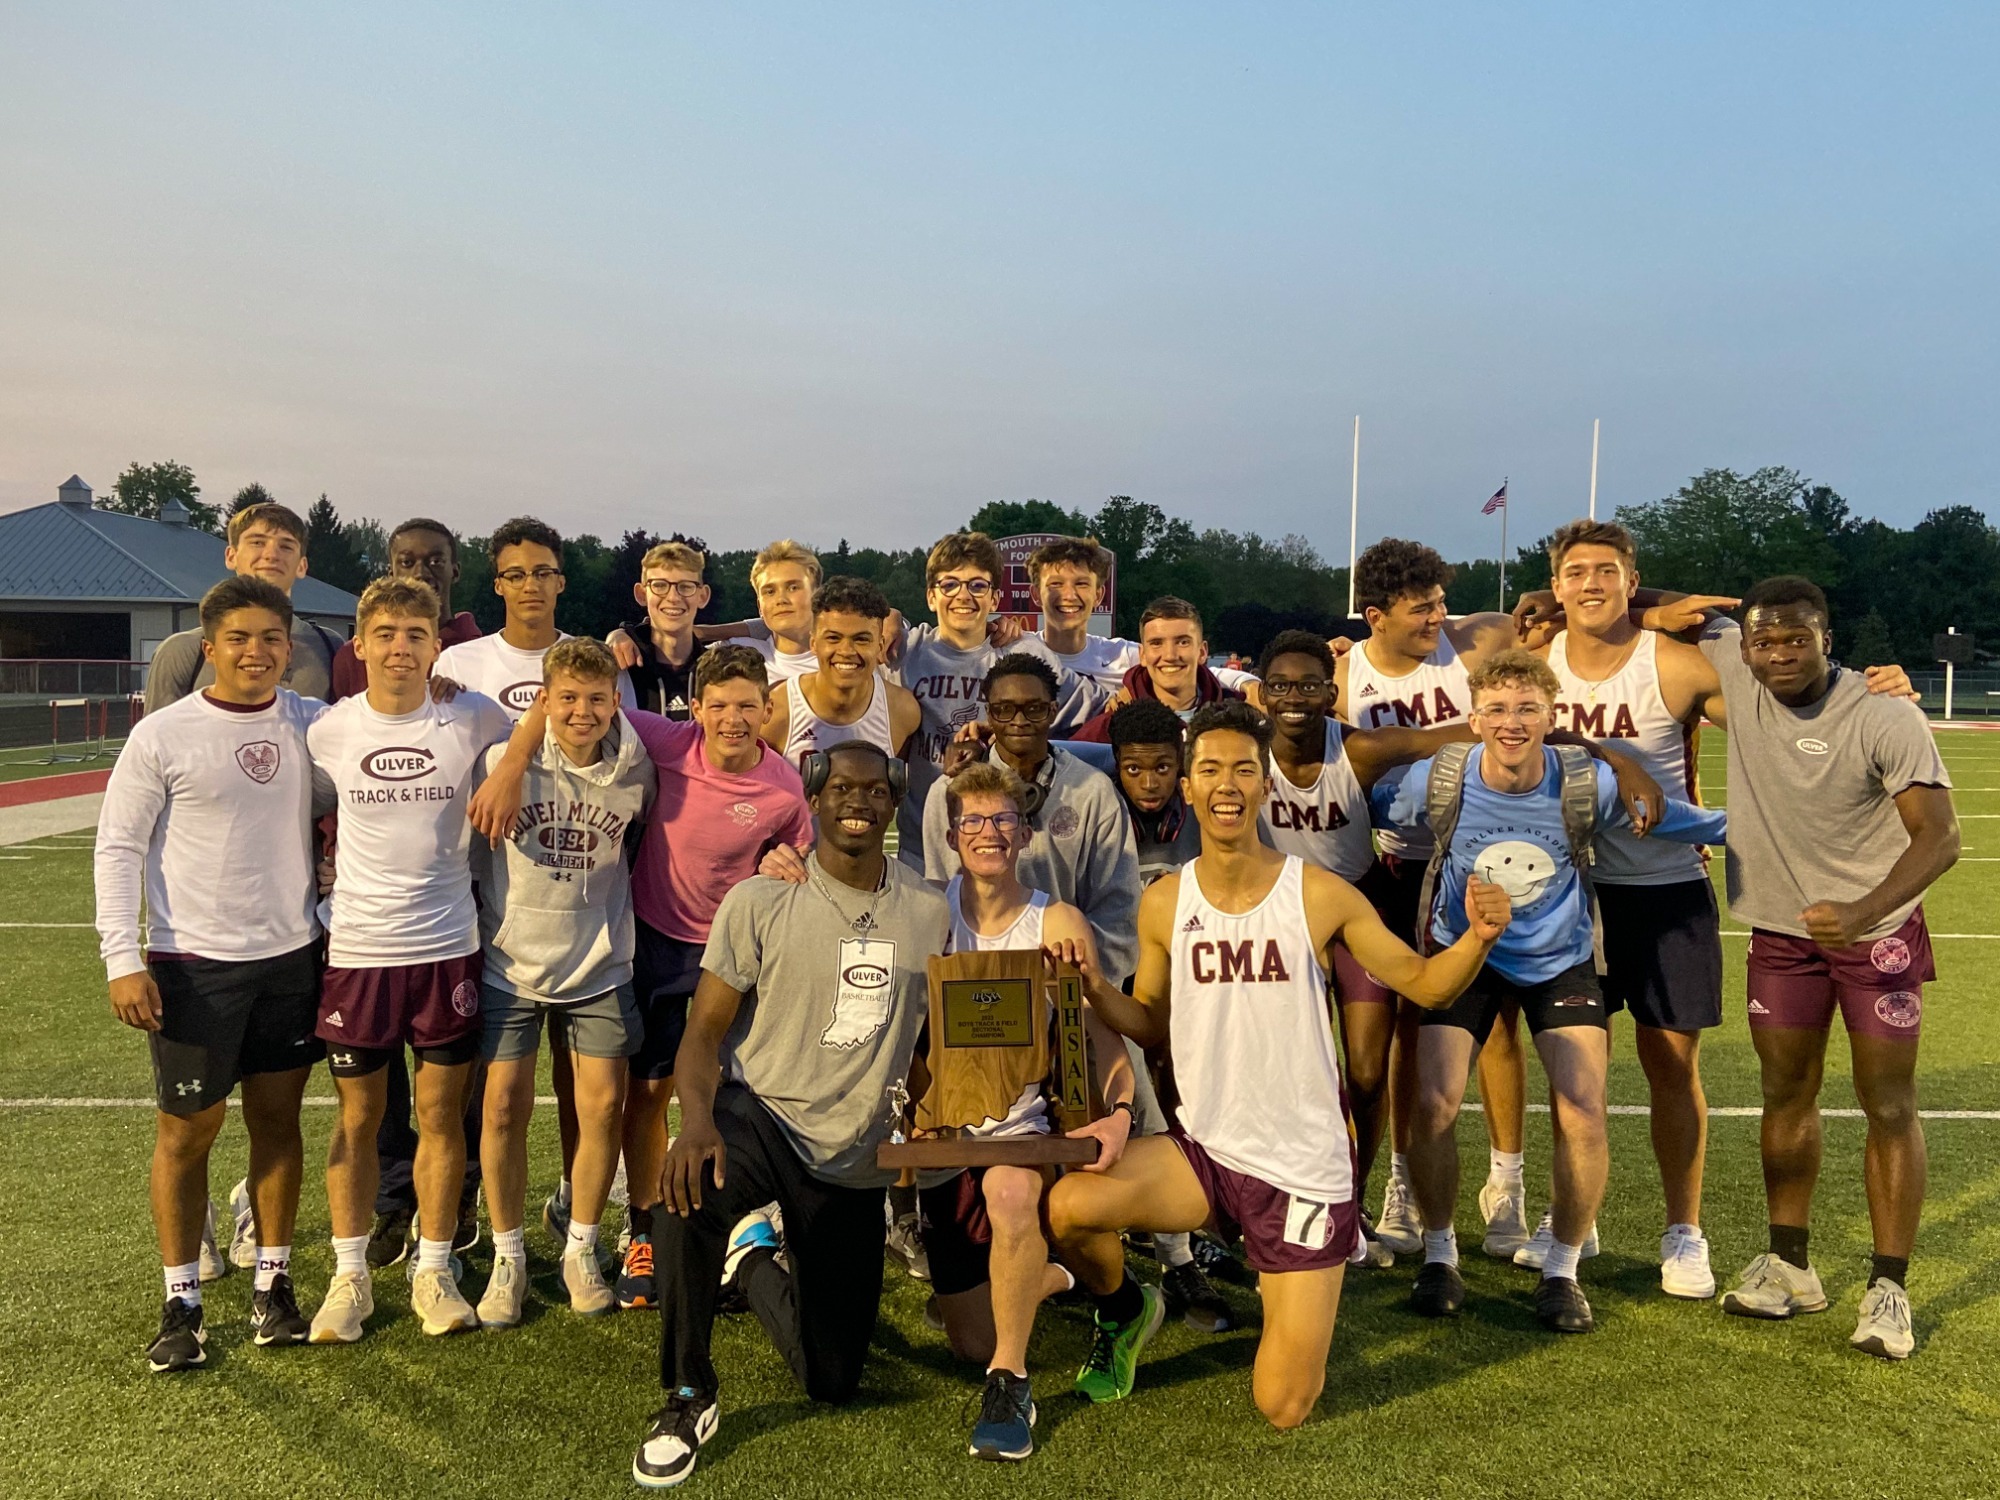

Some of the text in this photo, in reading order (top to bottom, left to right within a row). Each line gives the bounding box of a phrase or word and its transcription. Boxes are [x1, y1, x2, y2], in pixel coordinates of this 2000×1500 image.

[1010, 552, 1031, 561] FOO
[1011, 590, 1020, 598] TO
[1020, 590, 1030, 598] GO
[499, 681, 544, 711] CULV
[1370, 686, 1461, 728] CMA
[1553, 703, 1639, 737] CMA
[360, 747, 438, 782] CULVER
[349, 786, 454, 804] TRACK & FIELD
[513, 801, 562, 843] ULVER
[1271, 800, 1350, 832] CMA
[546, 829, 590, 850] 1894
[1465, 826, 1515, 849] CULVER
[542, 854, 587, 870] ACADEM
[842, 963, 889, 989] CULVER
[1192, 939, 1290, 984] CMA
[1296, 1196, 1326, 1243] 7
